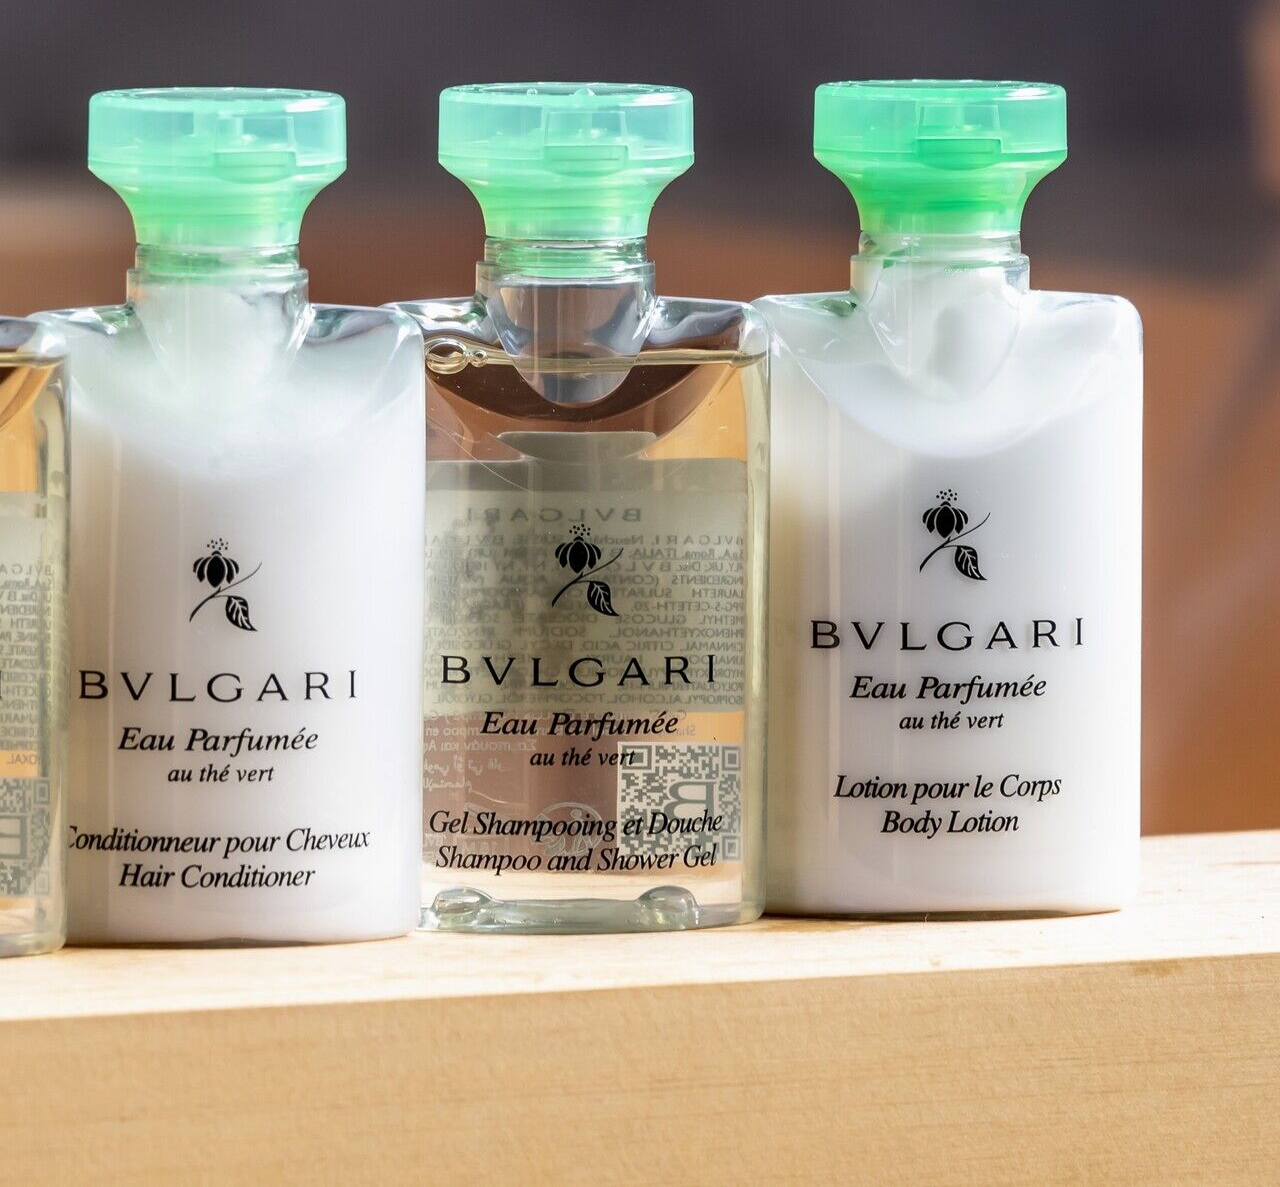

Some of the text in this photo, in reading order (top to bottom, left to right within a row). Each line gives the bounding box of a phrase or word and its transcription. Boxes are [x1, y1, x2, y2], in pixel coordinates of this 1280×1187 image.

[810, 617, 1084, 651] BVLGARI
[441, 654, 716, 687] BVLGARI
[79, 670, 357, 703] BVLGARI
[849, 674, 1047, 705] Eau Parfumée
[480, 712, 536, 735] Eau
[547, 711, 679, 741] Parfumée
[899, 711, 1004, 730] au thé vert
[118, 727, 319, 757] Eau Parfumée
[530, 747, 635, 766] au thé vert
[167, 764, 274, 783] au thé vert
[833, 774, 1062, 805] Lotion pour le Corps
[429, 810, 468, 834] Gel
[472, 812, 617, 840] Shampooing
[623, 817, 644, 835] et
[648, 810, 723, 835] Douche
[881, 810, 1020, 839] Body Lotion
[222, 834, 280, 859] pour
[286, 828, 371, 851] Cheveux
[435, 845, 542, 876] Shampoo
[548, 846, 592, 871] and
[596, 846, 679, 870] Shower
[683, 845, 716, 867] Gel
[118, 863, 316, 889] Hair Conditioner
